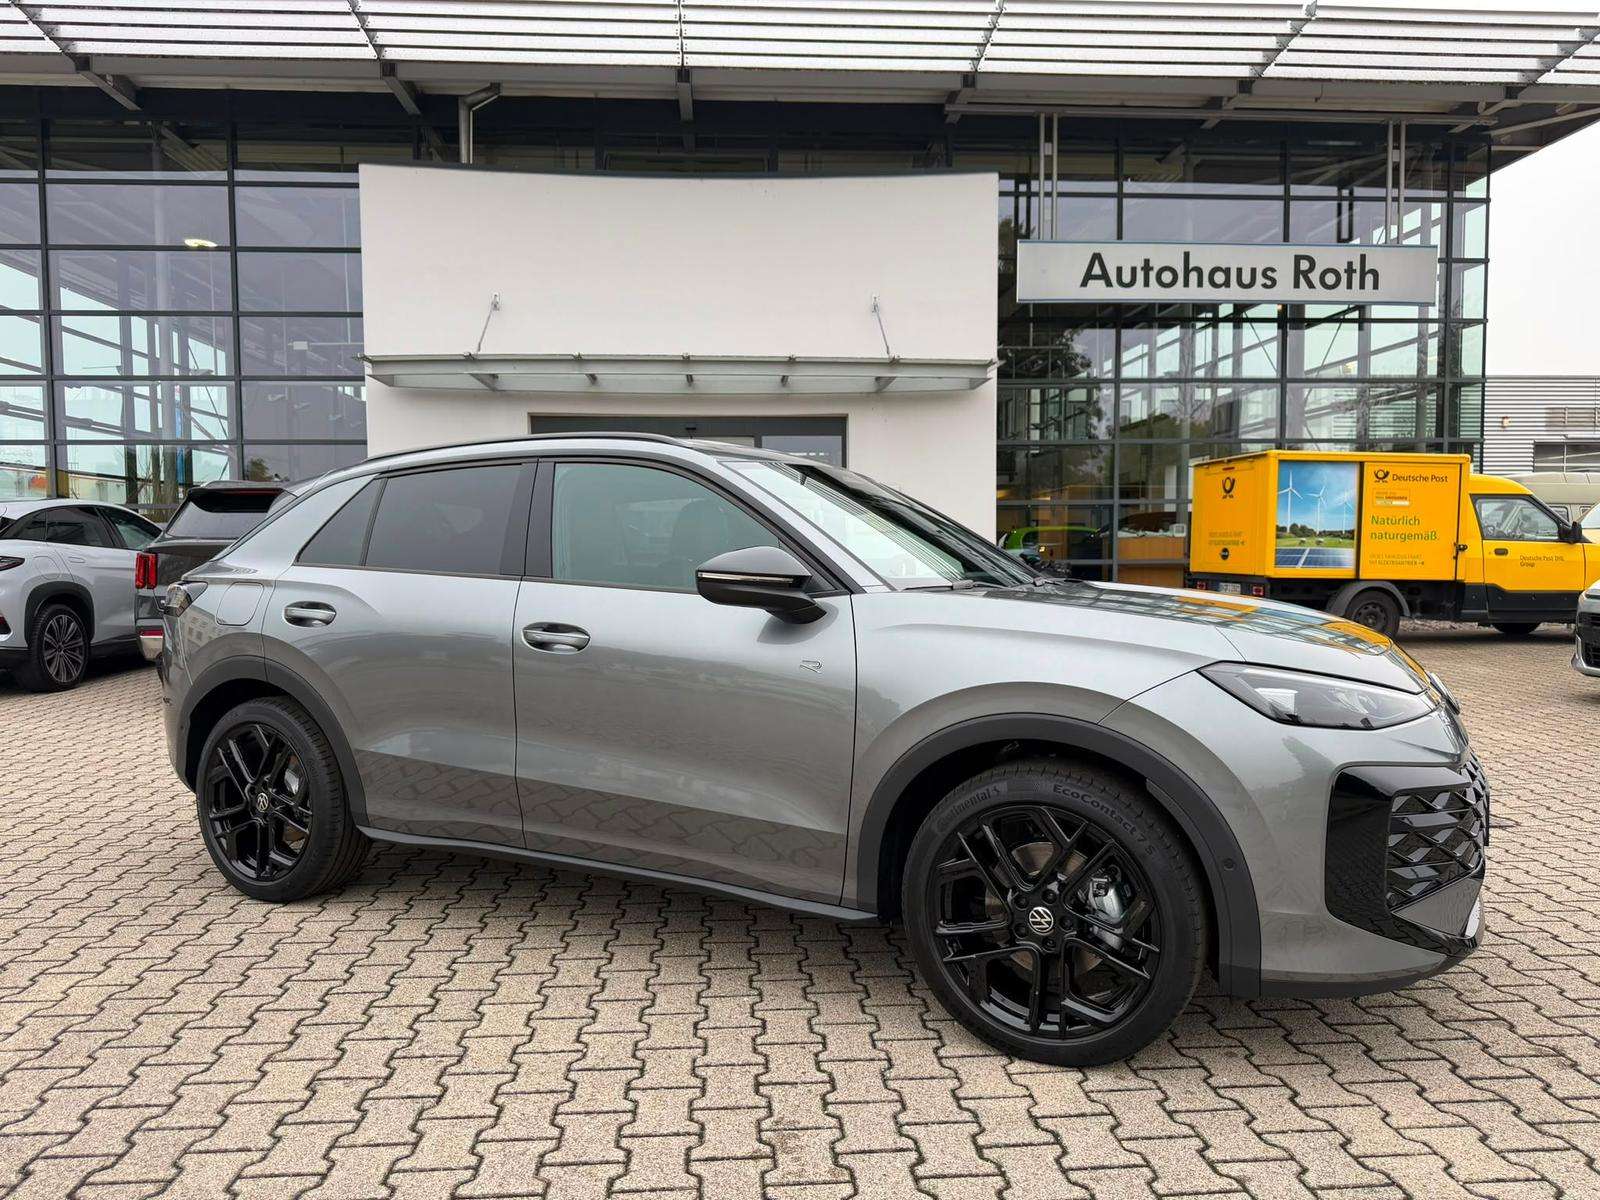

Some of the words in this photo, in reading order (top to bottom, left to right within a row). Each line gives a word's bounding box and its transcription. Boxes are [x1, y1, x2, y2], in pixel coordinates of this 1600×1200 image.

[1080, 251, 1278, 290] Autohaus
[1292, 254, 1380, 290] Roth
[1392, 474, 1429, 483] Deutsche
[1431, 475, 1448, 483] Post
[1371, 515, 1420, 526] Natürlich
[1053, 784, 1137, 835] EcoContact
